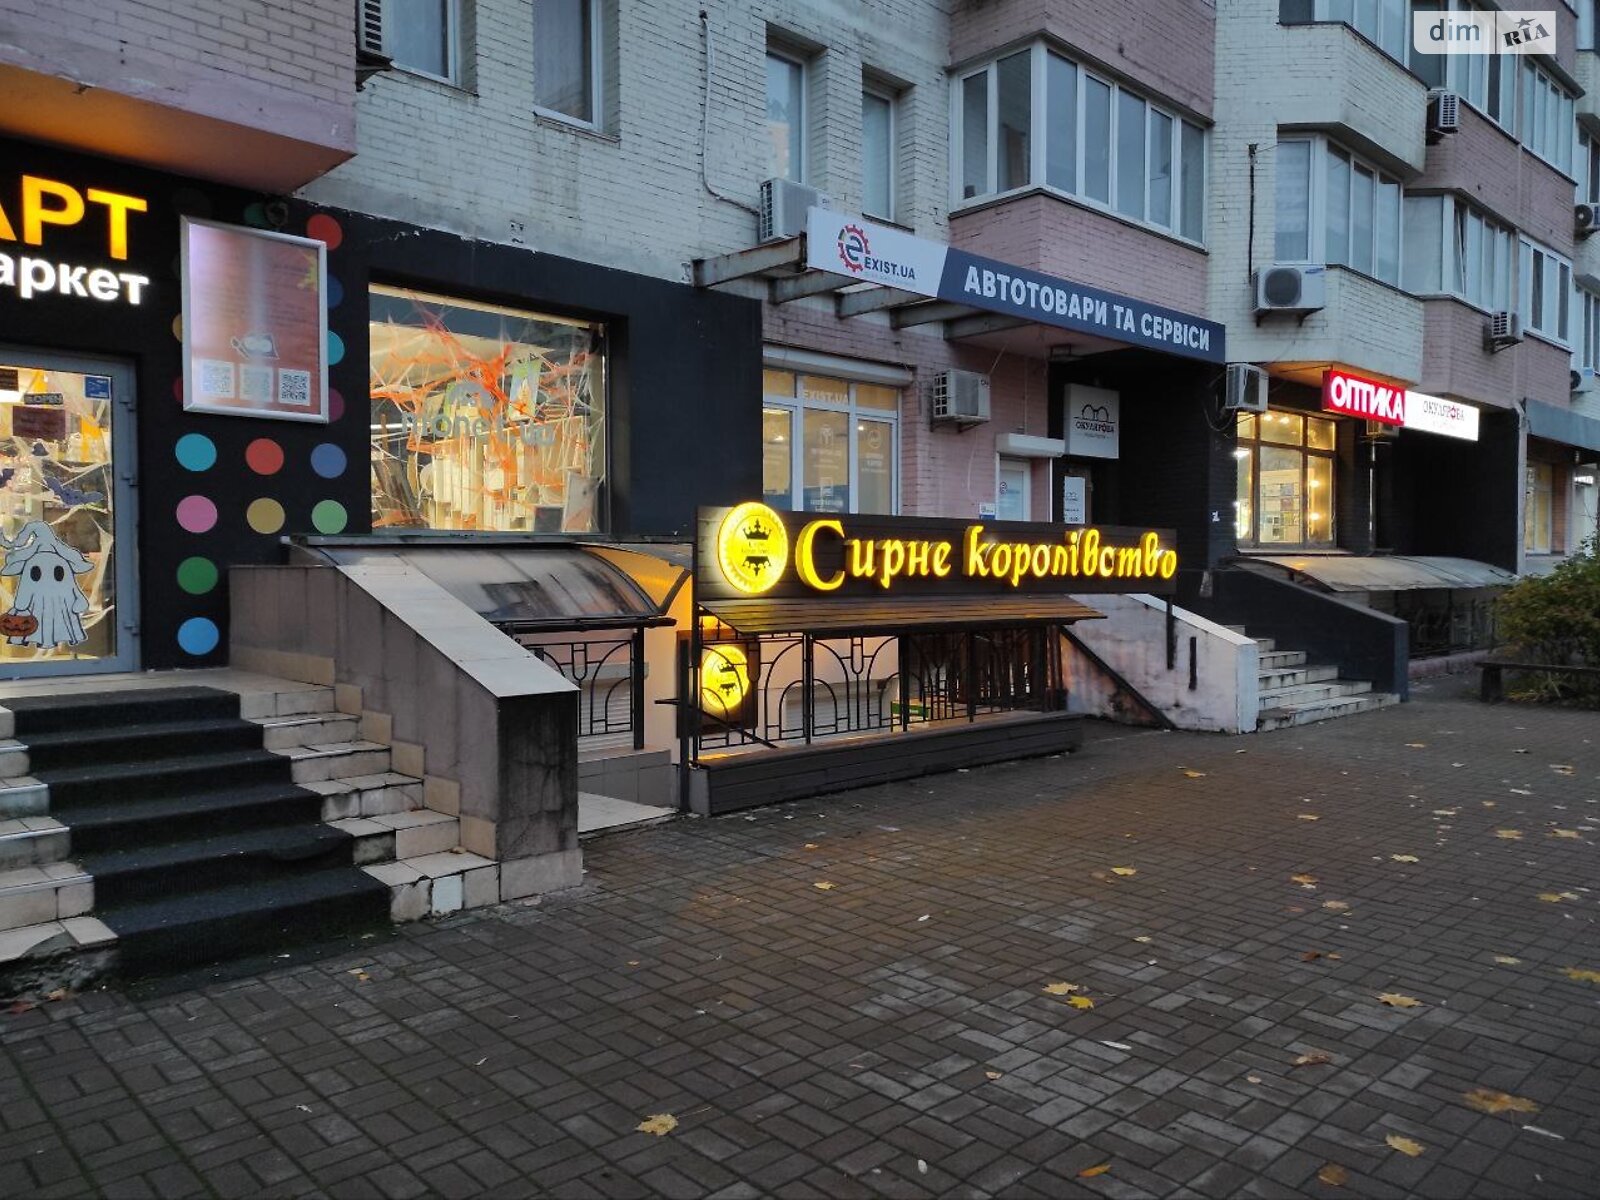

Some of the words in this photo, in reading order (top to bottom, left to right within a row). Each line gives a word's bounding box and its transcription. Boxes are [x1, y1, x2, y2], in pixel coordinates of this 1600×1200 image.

[864, 256, 916, 280] EXIST.UA
[964, 265, 1107, 326] АВТОТОВАРИ
[1113, 304, 1136, 333] ТА
[1140, 312, 1210, 351] СЕРВІСИ
[1331, 375, 1405, 422] ОПТИКА
[795, 519, 952, 591] Сирне
